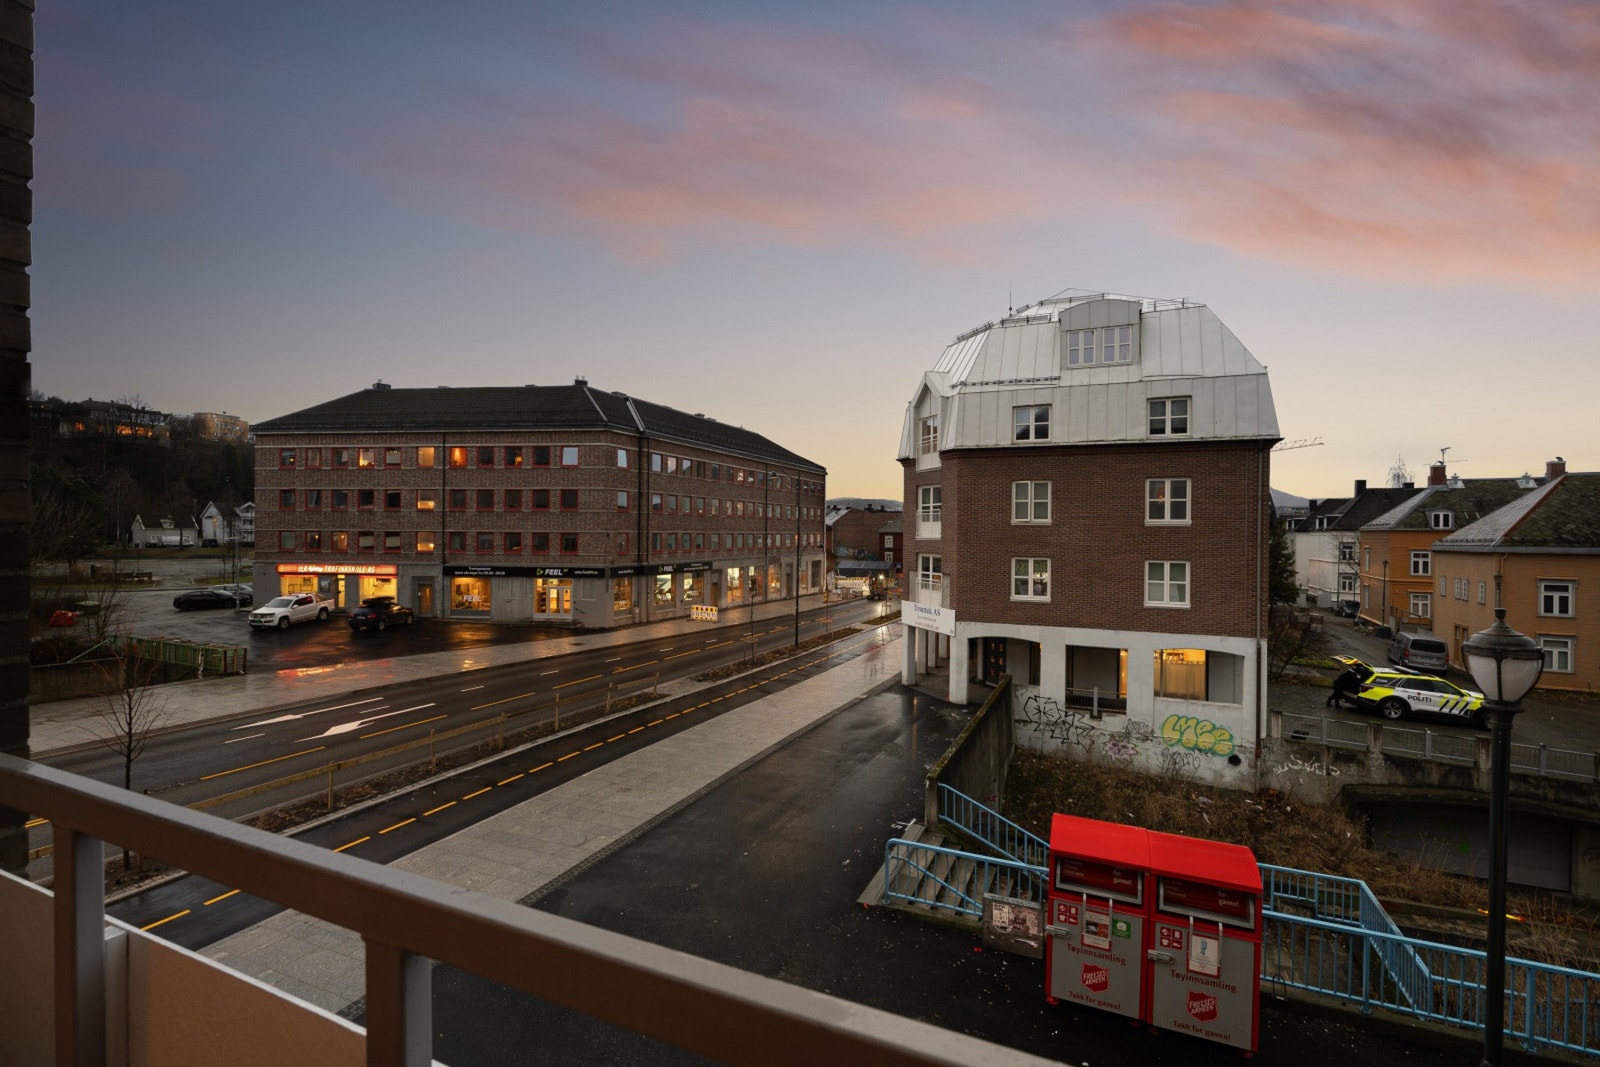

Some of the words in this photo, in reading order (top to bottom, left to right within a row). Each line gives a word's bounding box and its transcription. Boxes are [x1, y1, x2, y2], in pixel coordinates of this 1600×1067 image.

[297, 565, 306, 573] ILA
[324, 565, 366, 573] TRAFIKKSKOLE
[367, 565, 376, 573] AS
[544, 568, 563, 576] FEEL
[1407, 694, 1432, 703] POLITI
[1067, 943, 1126, 966] Tøyinnsamling
[1083, 970, 1107, 981] FRELSES
[1084, 976, 1106, 986] ARMEEN
[1170, 969, 1237, 994] Tøyinnsamling
[1069, 991, 1085, 1000] Takk
[1086, 996, 1096, 1004] for
[1097, 999, 1121, 1010] gaven!
[1189, 997, 1215, 1009] FRELSES
[1173, 1020, 1193, 1031] Takk
[1192, 1024, 1204, 1034] for
[1205, 1030, 1231, 1041] gaven!
